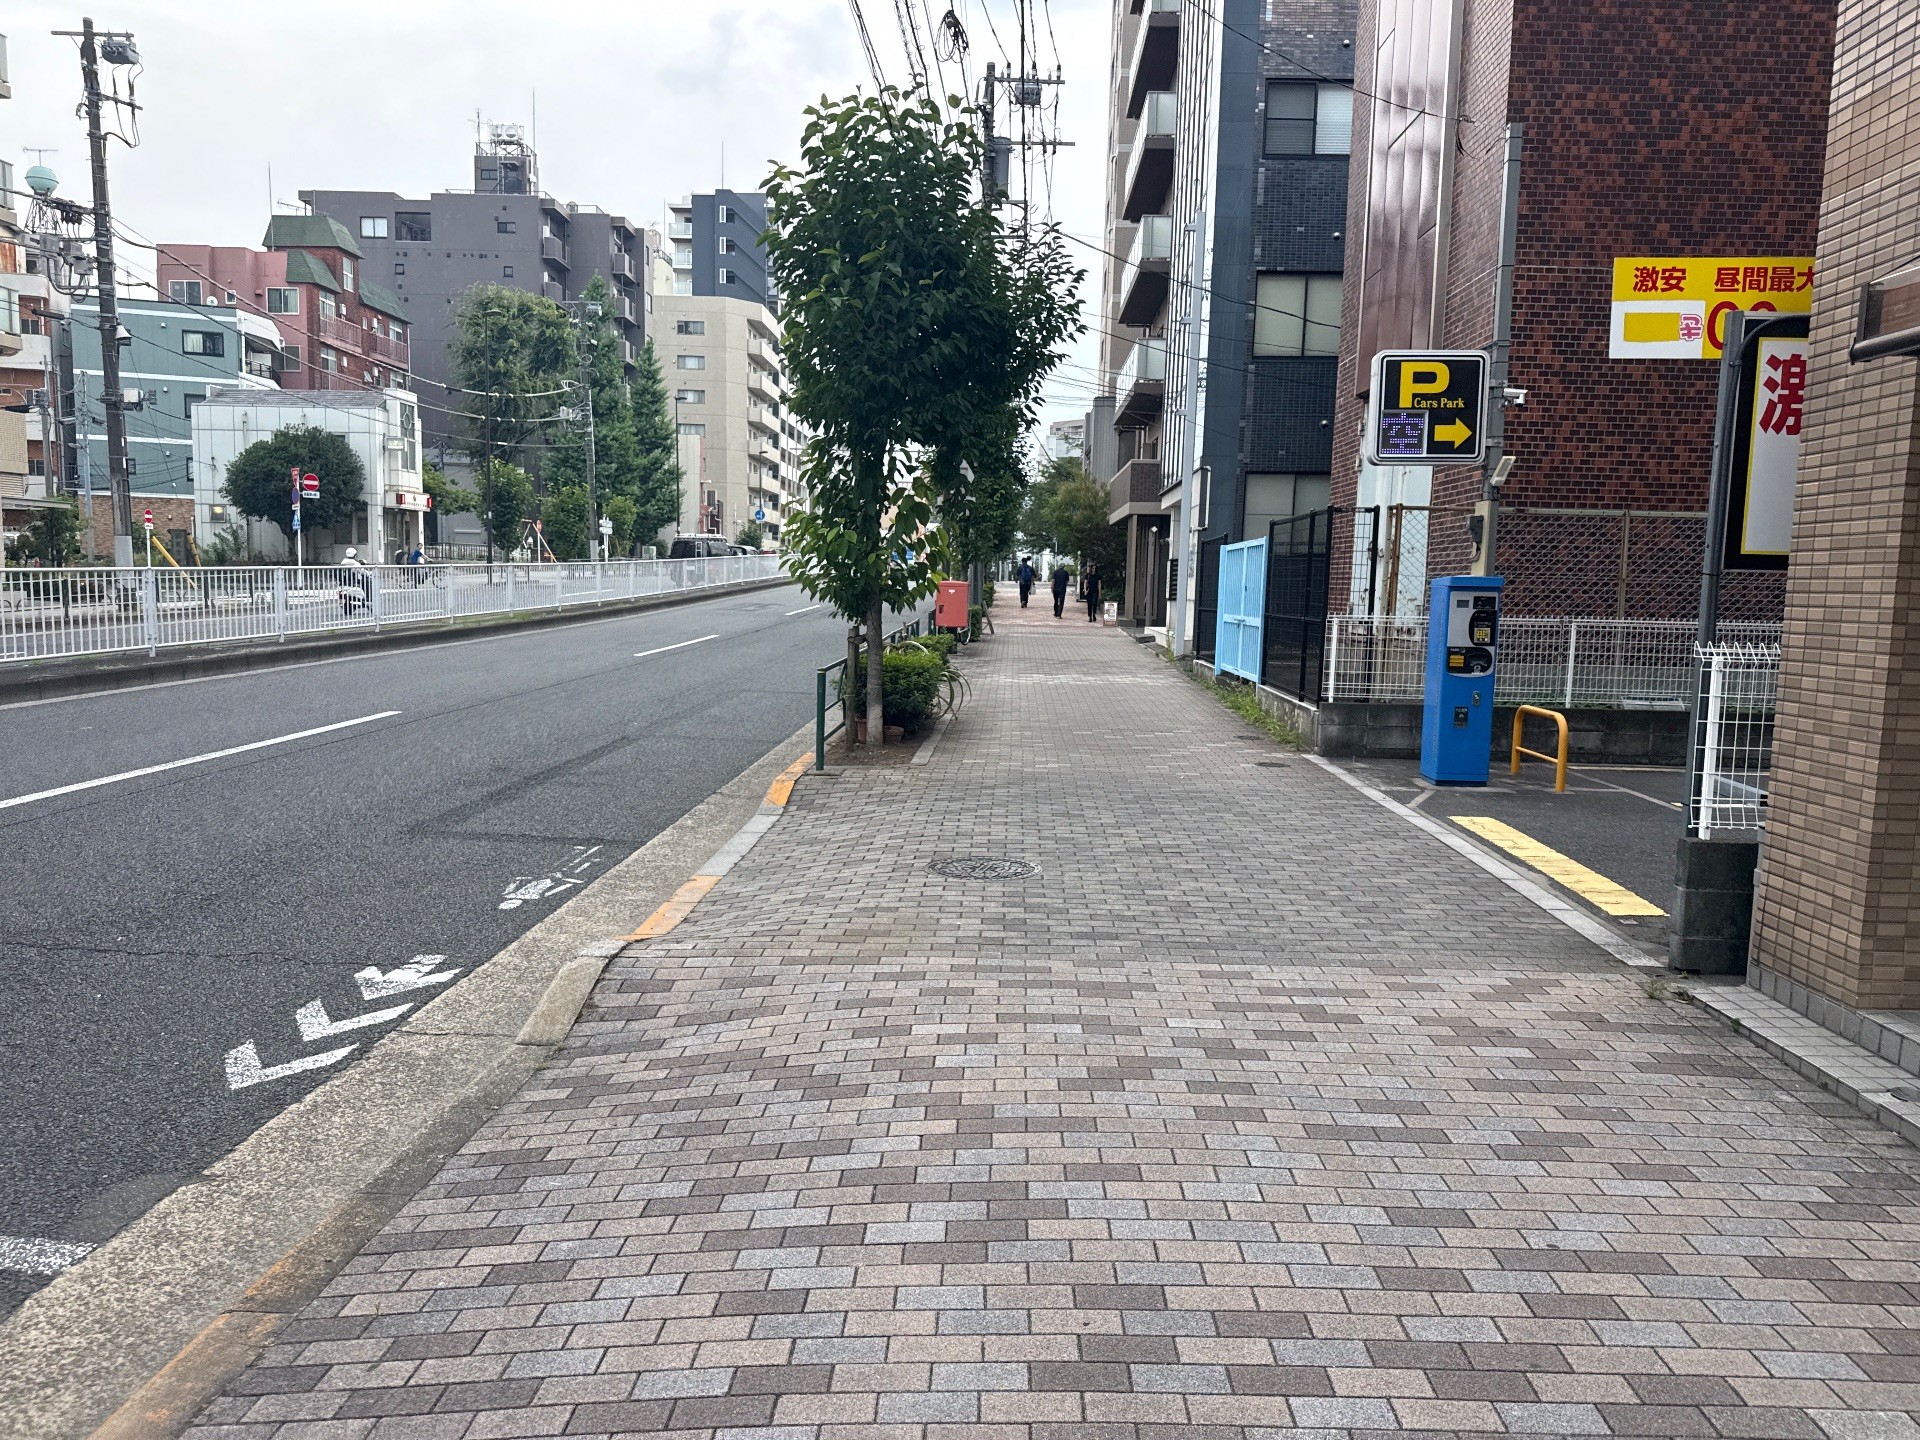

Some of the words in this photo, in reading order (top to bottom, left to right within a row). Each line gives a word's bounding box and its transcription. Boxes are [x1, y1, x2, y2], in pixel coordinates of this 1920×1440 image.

[1632, 266, 1687, 293] 激安
[1714, 266, 1815, 293] 昼間最大
[1399, 361, 1450, 408] P
[1414, 397, 1438, 408] Cars
[1440, 397, 1465, 408] Park
[1381, 412, 1424, 454] 空
